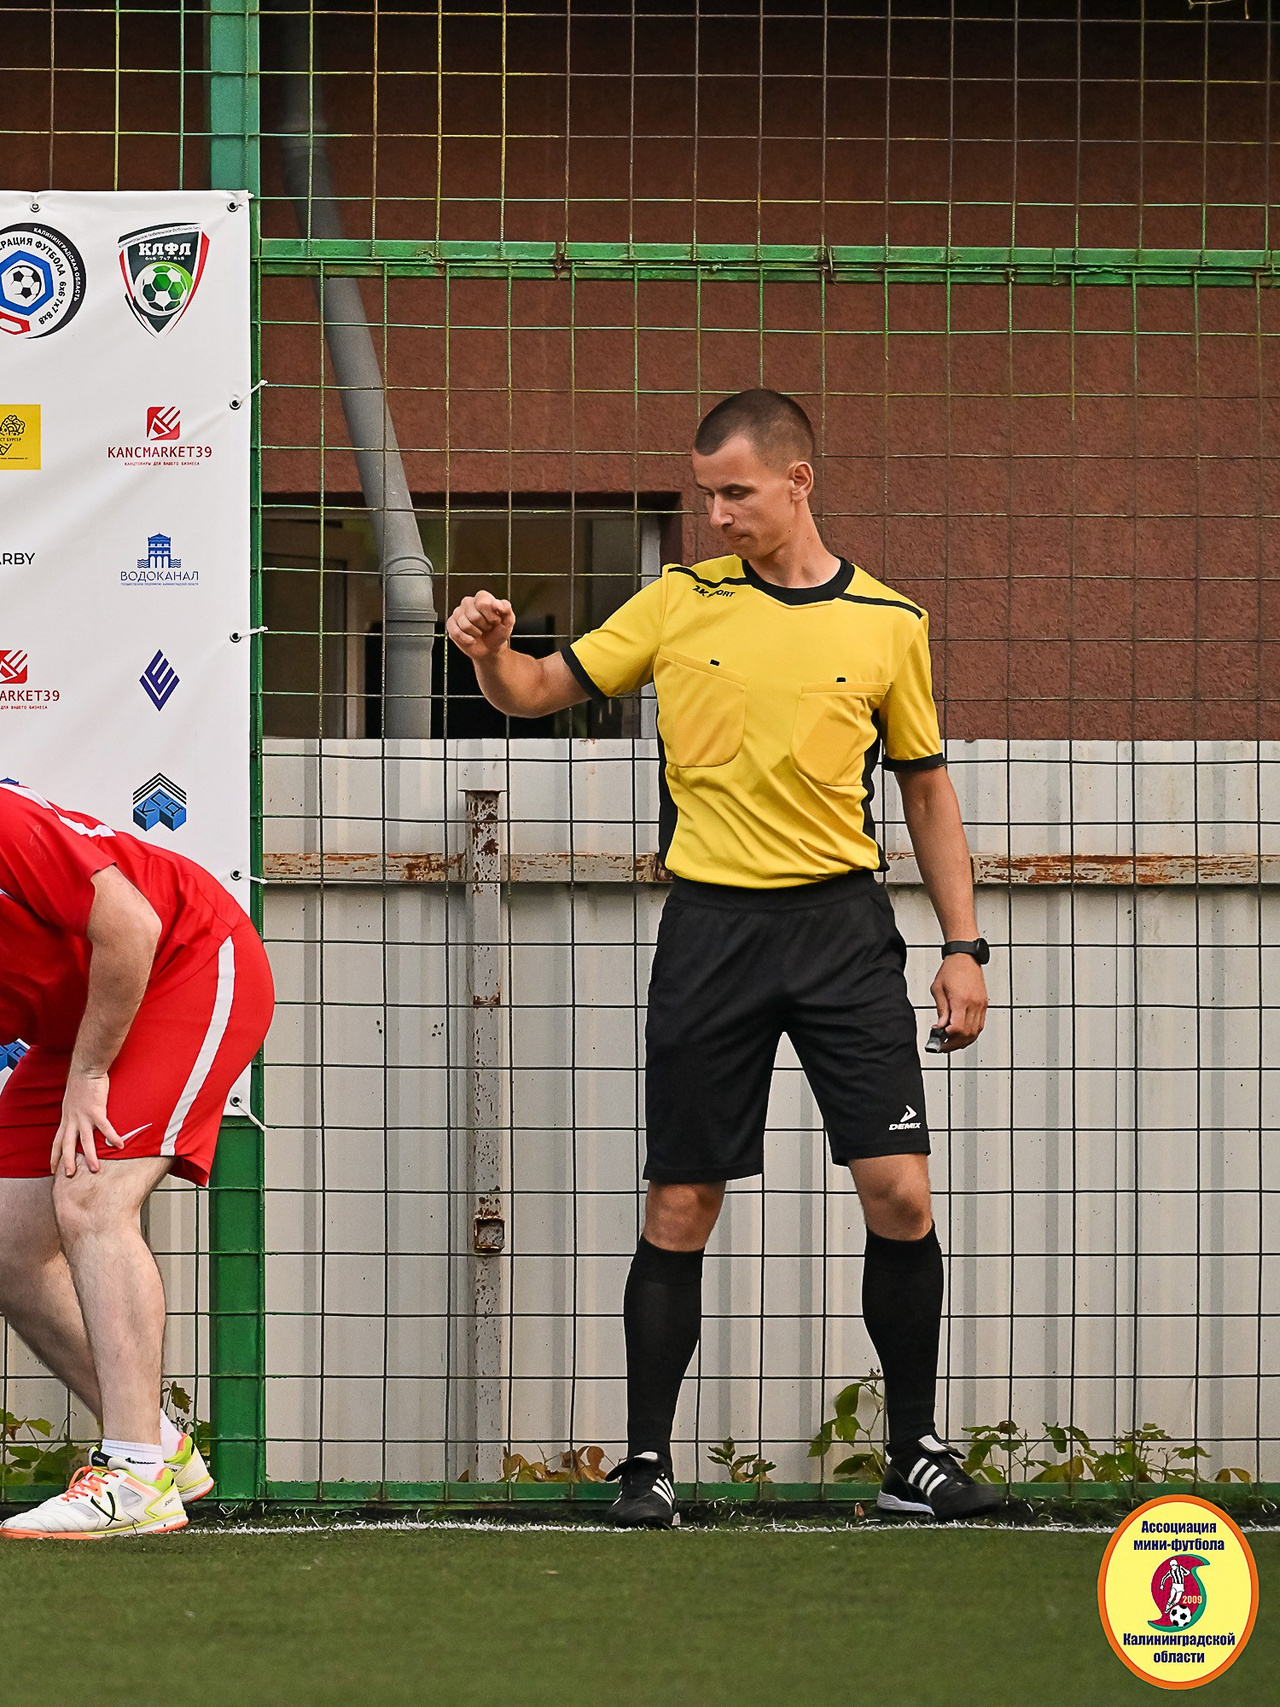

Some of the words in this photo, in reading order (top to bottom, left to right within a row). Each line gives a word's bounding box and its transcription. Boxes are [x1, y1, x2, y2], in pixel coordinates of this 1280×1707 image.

[138, 242, 192, 256] КЛФЛ
[35, 240, 66, 276] ФУТБОЛА
[107, 446, 212, 458] KANCMARKET39
[120, 571, 199, 582] ВОДОКАНАЛ
[888, 1122, 921, 1131] DEMIX
